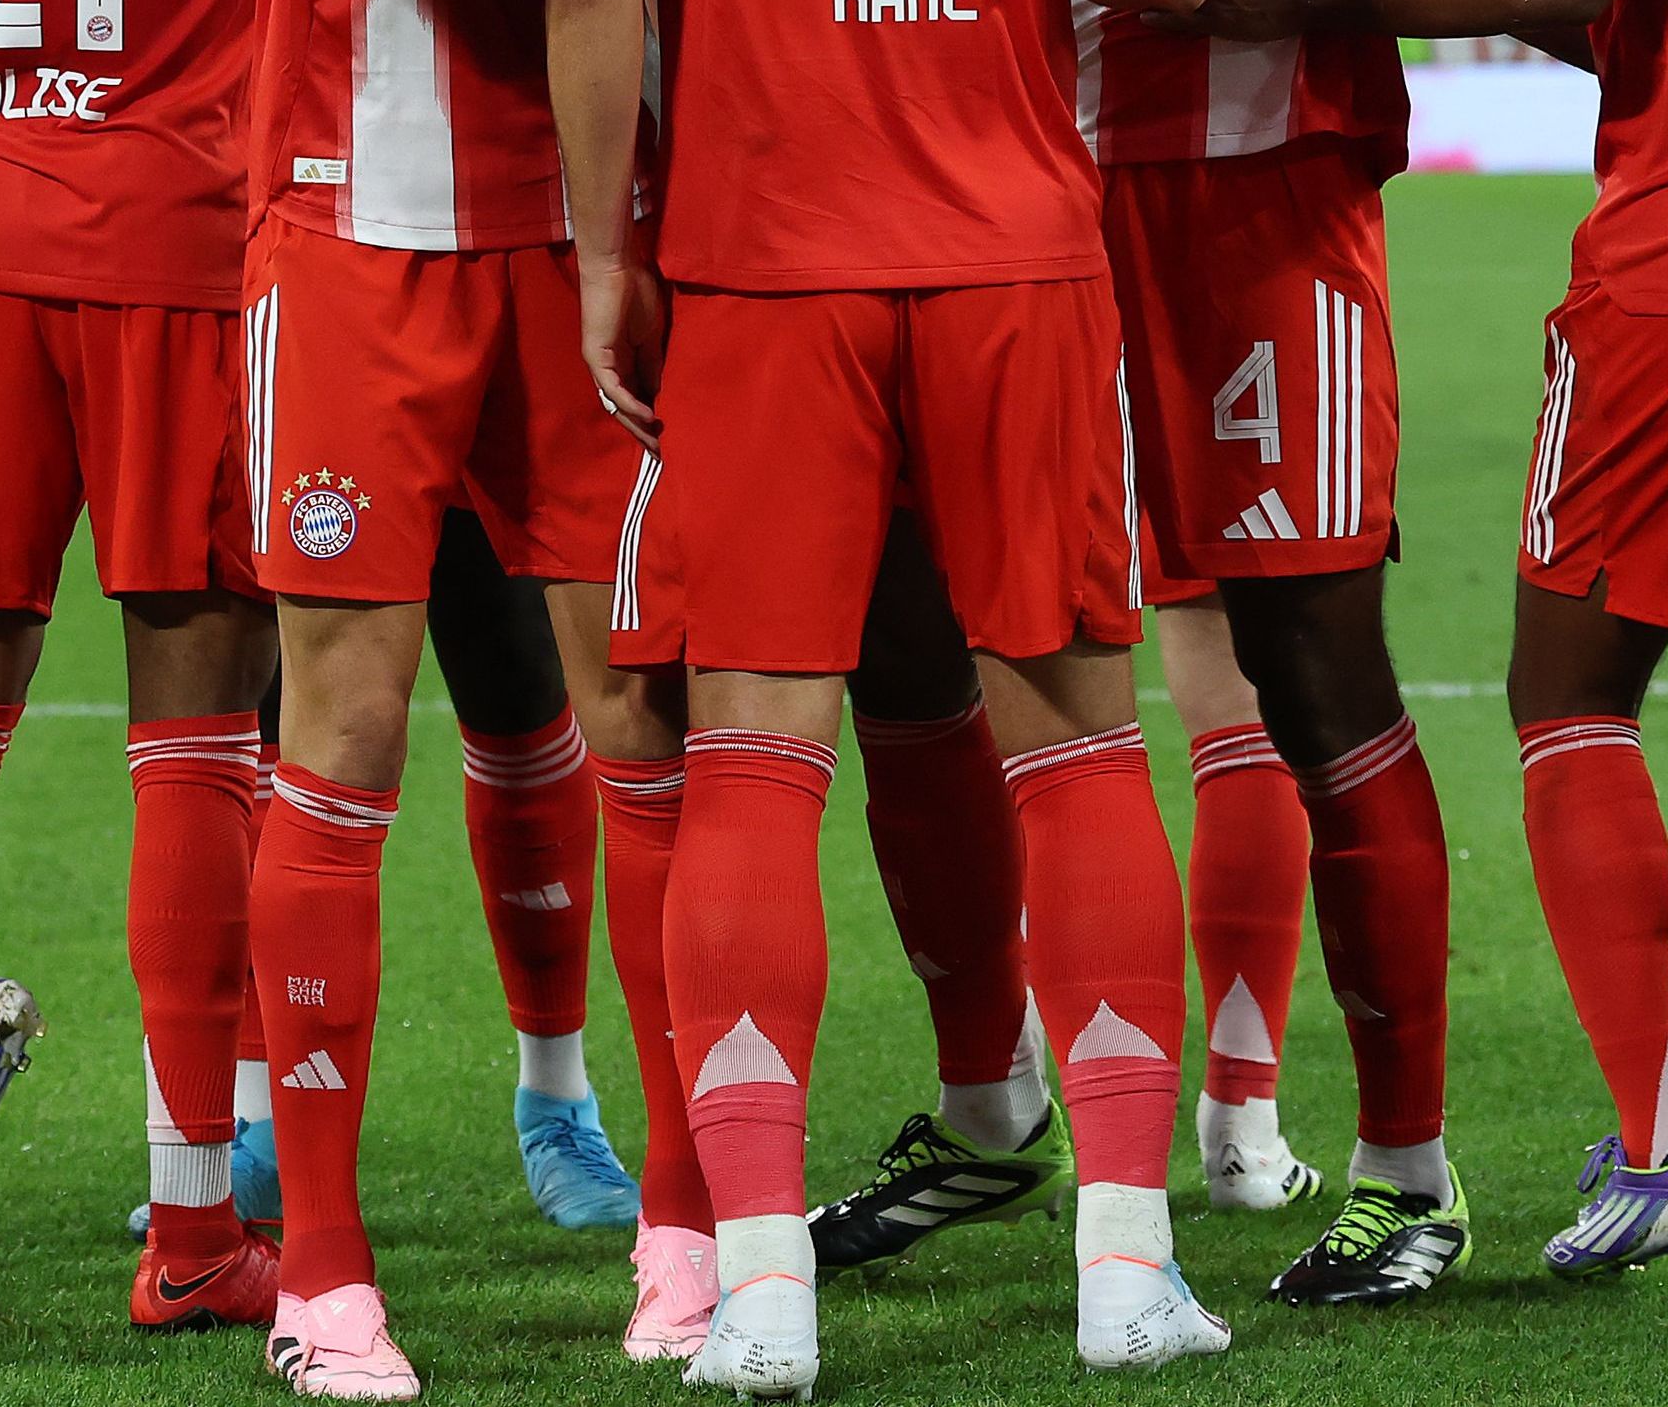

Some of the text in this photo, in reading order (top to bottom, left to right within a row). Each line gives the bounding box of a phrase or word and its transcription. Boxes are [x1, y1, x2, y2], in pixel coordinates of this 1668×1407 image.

[1213, 340, 1281, 464] 4
[295, 494, 351, 522] FC BAYERN
[294, 529, 349, 554] MÜNCHEN
[287, 975, 326, 988] MIA
[288, 993, 325, 1007] MIA
